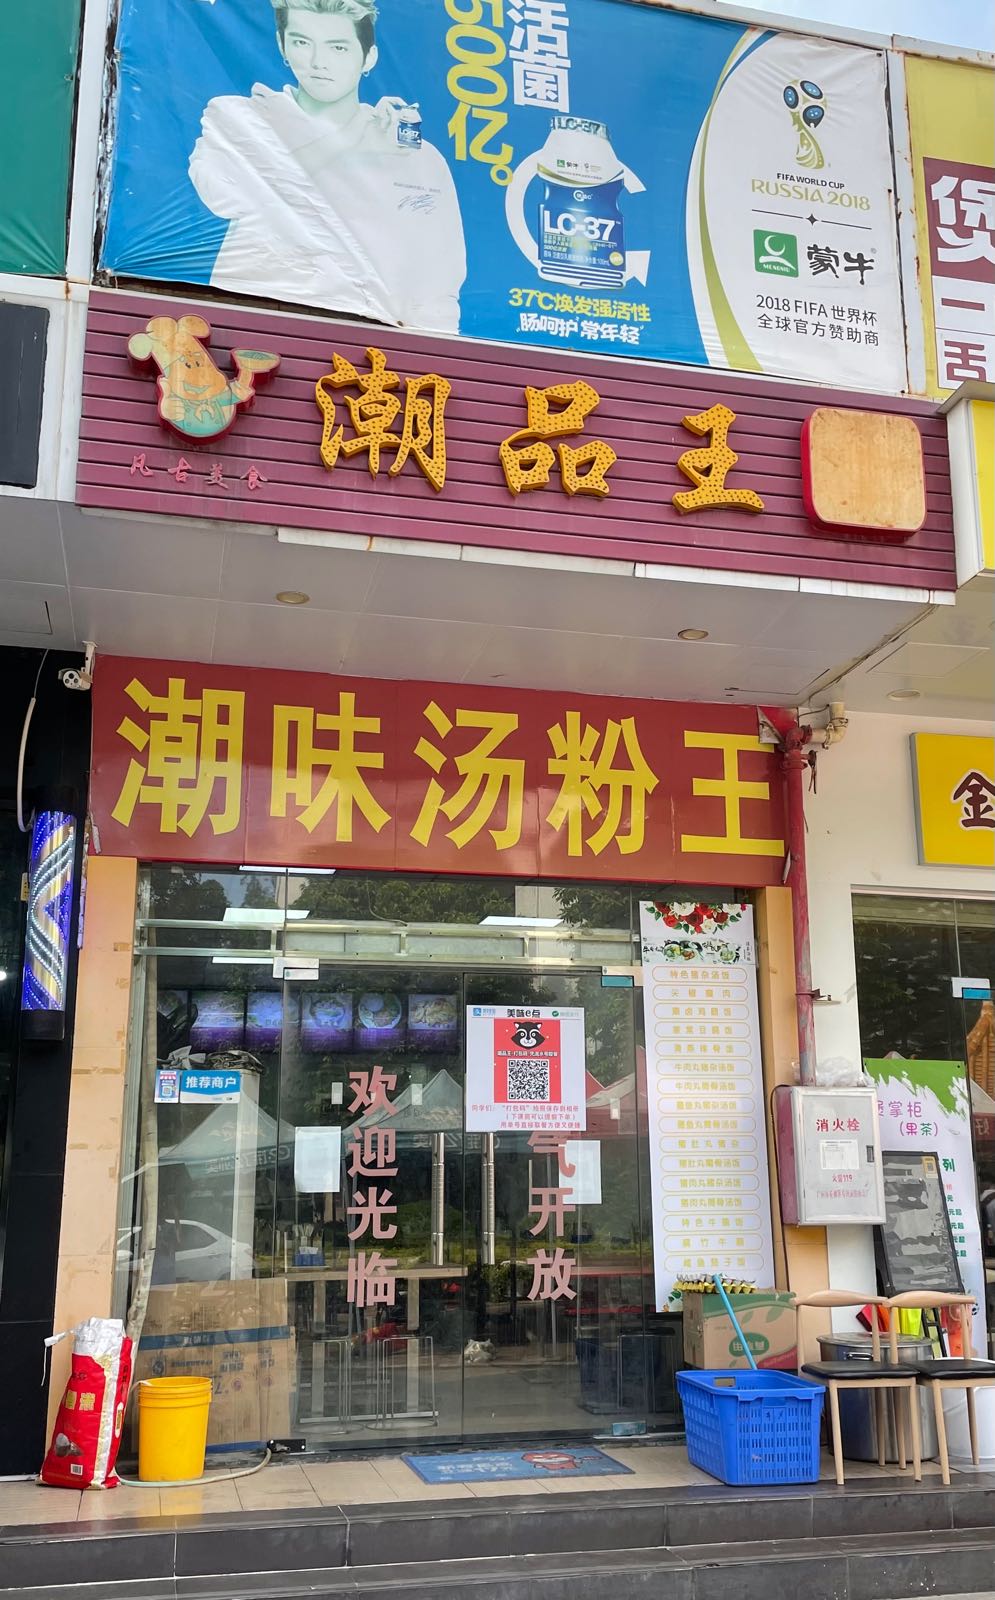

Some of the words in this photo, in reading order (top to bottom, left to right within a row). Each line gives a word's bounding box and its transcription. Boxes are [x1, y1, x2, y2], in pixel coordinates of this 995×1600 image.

[506, 0, 571, 114] 活菌
[751, 178, 825, 203] RUSSIA
[826, 191, 871, 211] 2018
[776, 172, 796, 182] FIFA
[796, 175, 827, 187] WORLD
[828, 181, 845, 190] CUP
[543, 210, 615, 241] LC-37
[806, 243, 874, 285] 蒙牛
[756, 294, 791, 312] 2018
[794, 299, 828, 318] FIFA
[830, 304, 878, 327] 世界杯
[757, 312, 879, 347] 全球官方赞助商
[314, 346, 764, 515] 潮品王
[111, 677, 785, 857] 潮味汤粉王
[185, 1076, 237, 1090] 推荐商户
[816, 1118, 860, 1132] 消火栓
[899, 1121, 939, 1137] (果茶)
[942, 1158, 956, 1172] 列
[347, 1065, 399, 1309] 欢迎光临
